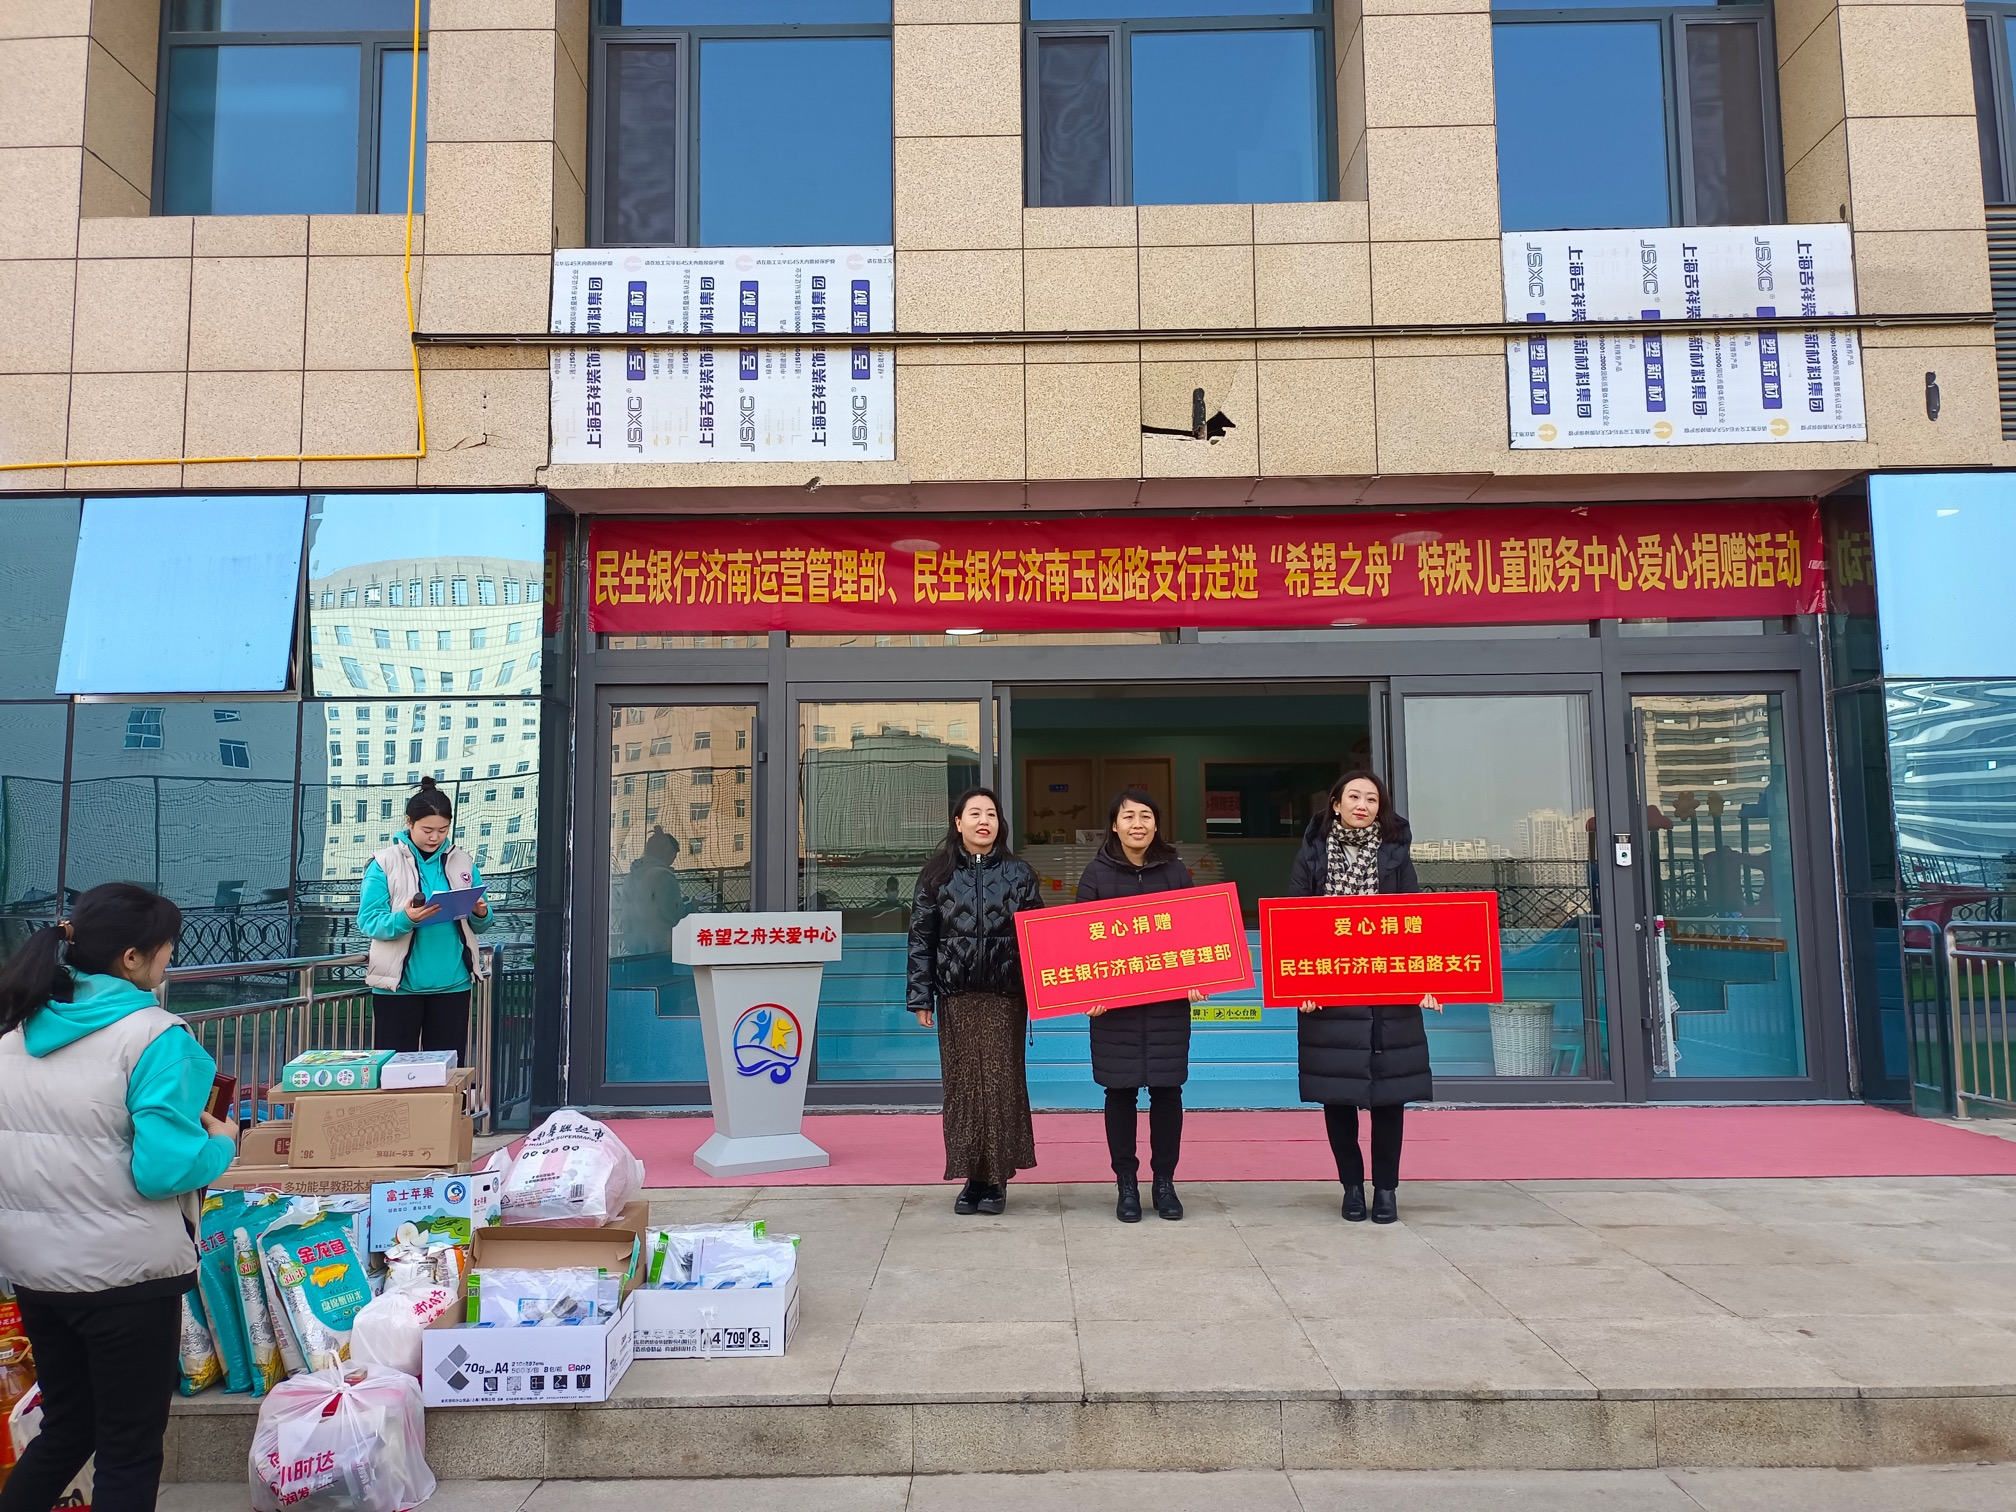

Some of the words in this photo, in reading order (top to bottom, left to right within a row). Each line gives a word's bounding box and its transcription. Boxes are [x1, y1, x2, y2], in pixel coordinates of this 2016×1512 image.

[1526, 242, 1544, 298] JSXC
[1640, 239, 1659, 295] JSXC
[1754, 235, 1774, 292] JSXC
[628, 396, 642, 454] JSXC
[740, 396, 755, 452] JSXC
[852, 395, 868, 451] JSXC
[696, 926, 837, 946] 希望之舟关爱中心
[1088, 912, 1172, 942] 爱心捐赠
[1334, 915, 1423, 937] 爱心捐赠
[1040, 944, 1232, 988] 民生银行济南运营管理部
[1280, 954, 1482, 977] 民生银行济南玉函路支行
[1226, 1008, 1257, 1016] 小心台阶
[386, 1186, 434, 1202] 富士苹果
[297, 1238, 348, 1265] 金龙鱼
[726, 1332, 745, 1345] 70g
[752, 1331, 760, 1344] 8
[494, 1362, 509, 1374] A4
